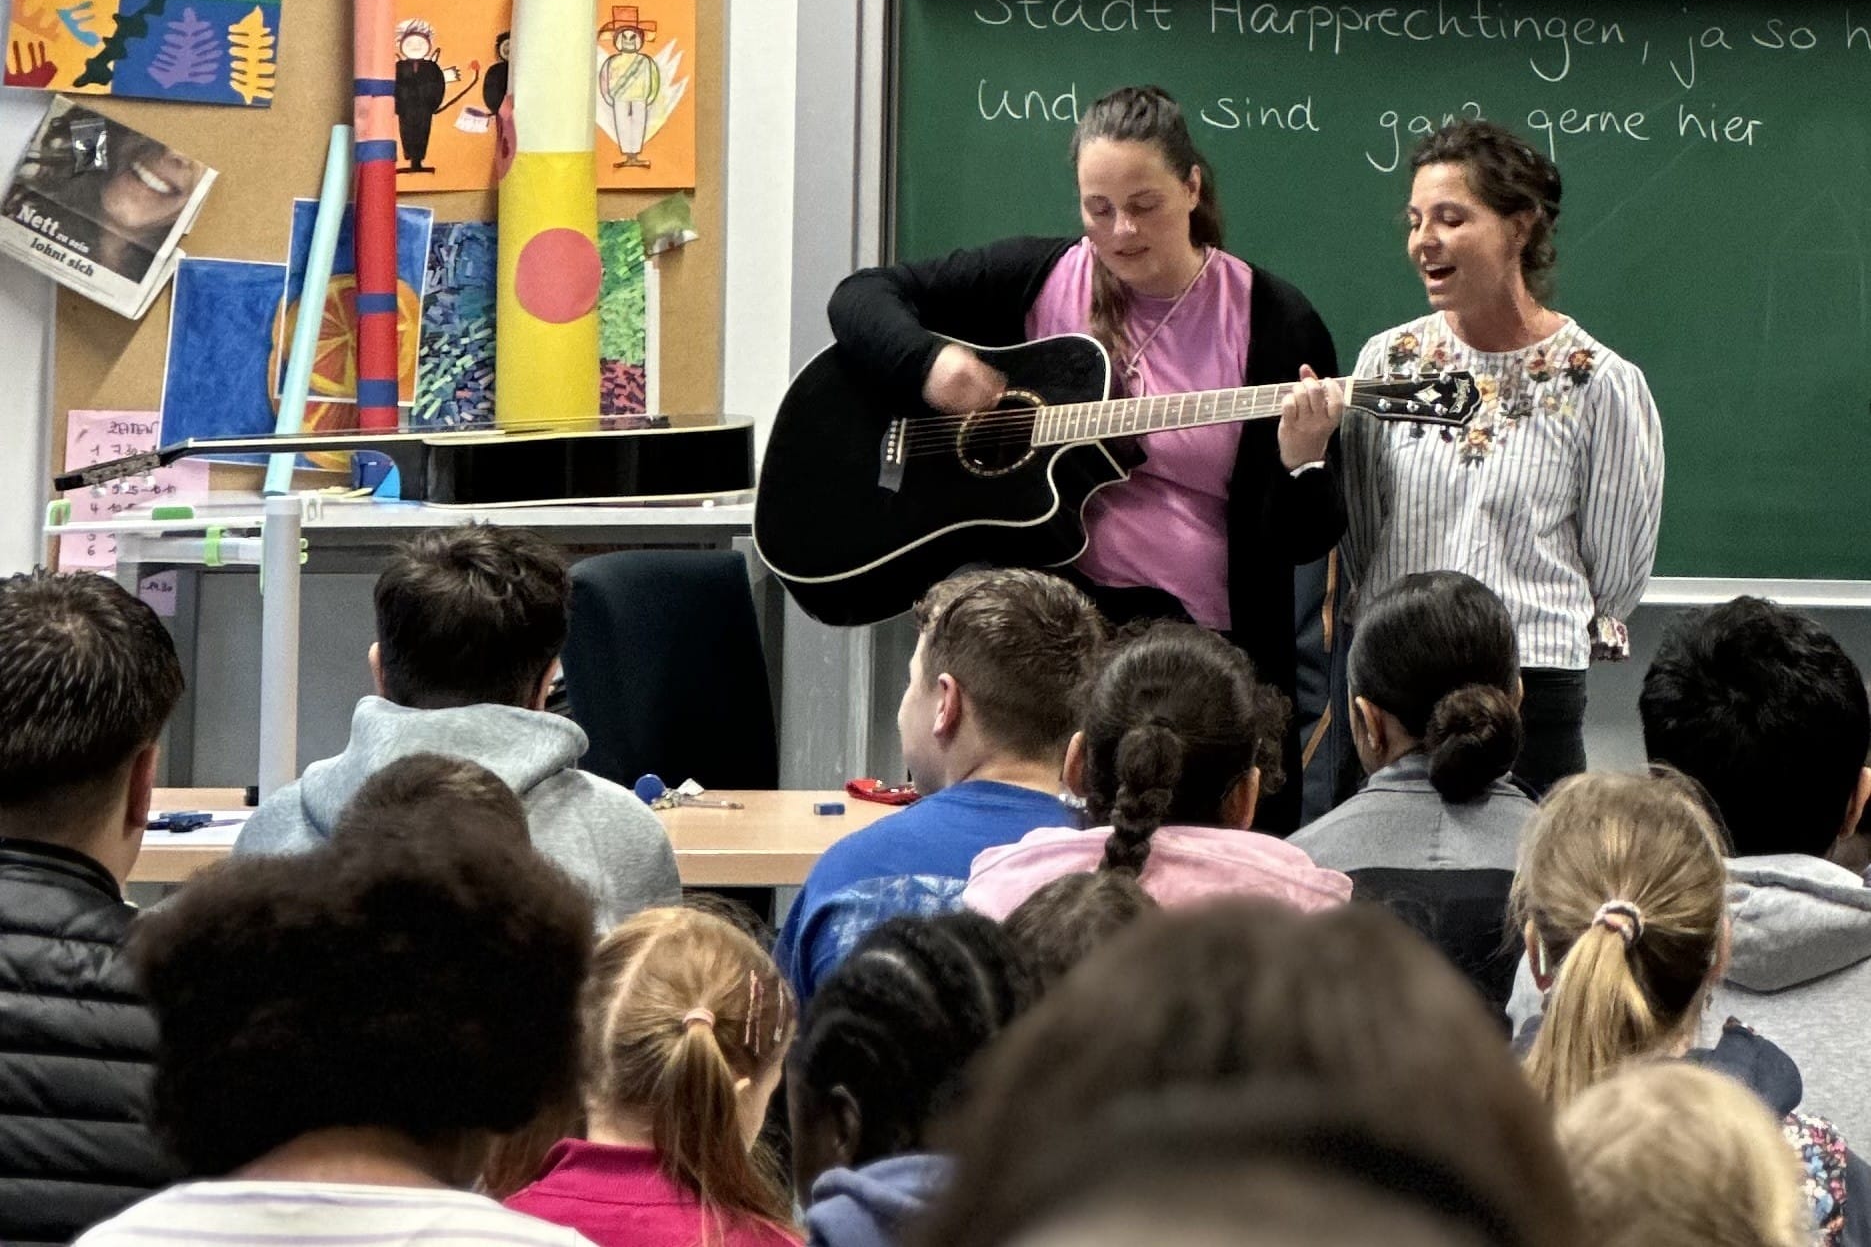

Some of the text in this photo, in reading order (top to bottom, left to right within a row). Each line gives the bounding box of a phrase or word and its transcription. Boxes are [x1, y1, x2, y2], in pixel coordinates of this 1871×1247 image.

[1669, 5, 1733, 90] ja
[1751, 17, 1818, 50] so
[1201, 95, 1321, 133] sind
[1677, 102, 1764, 147] hier
[17, 204, 60, 236] Nett
[31, 237, 94, 276] lohnt sich
